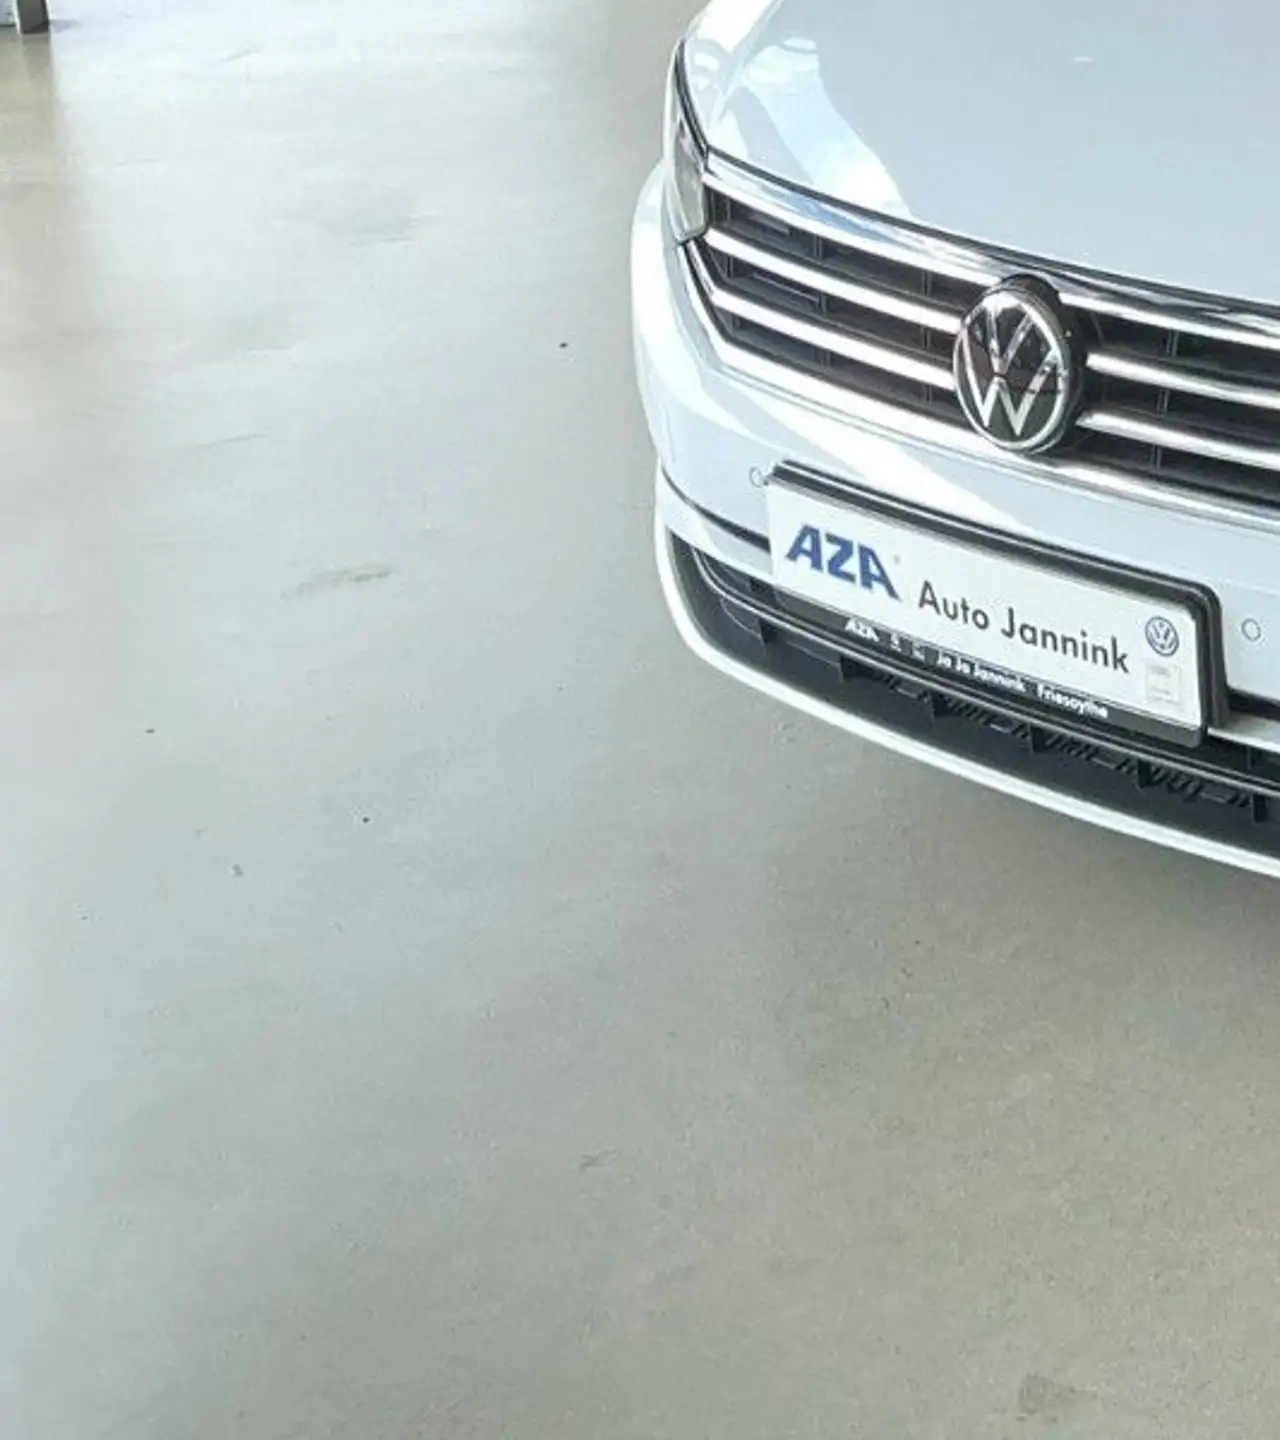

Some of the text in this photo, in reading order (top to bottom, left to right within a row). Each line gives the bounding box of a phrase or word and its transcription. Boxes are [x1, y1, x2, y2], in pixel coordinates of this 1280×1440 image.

[786, 524, 902, 601] AZA
[917, 579, 990, 631] Auto
[1000, 606, 1130, 674] Jannink
